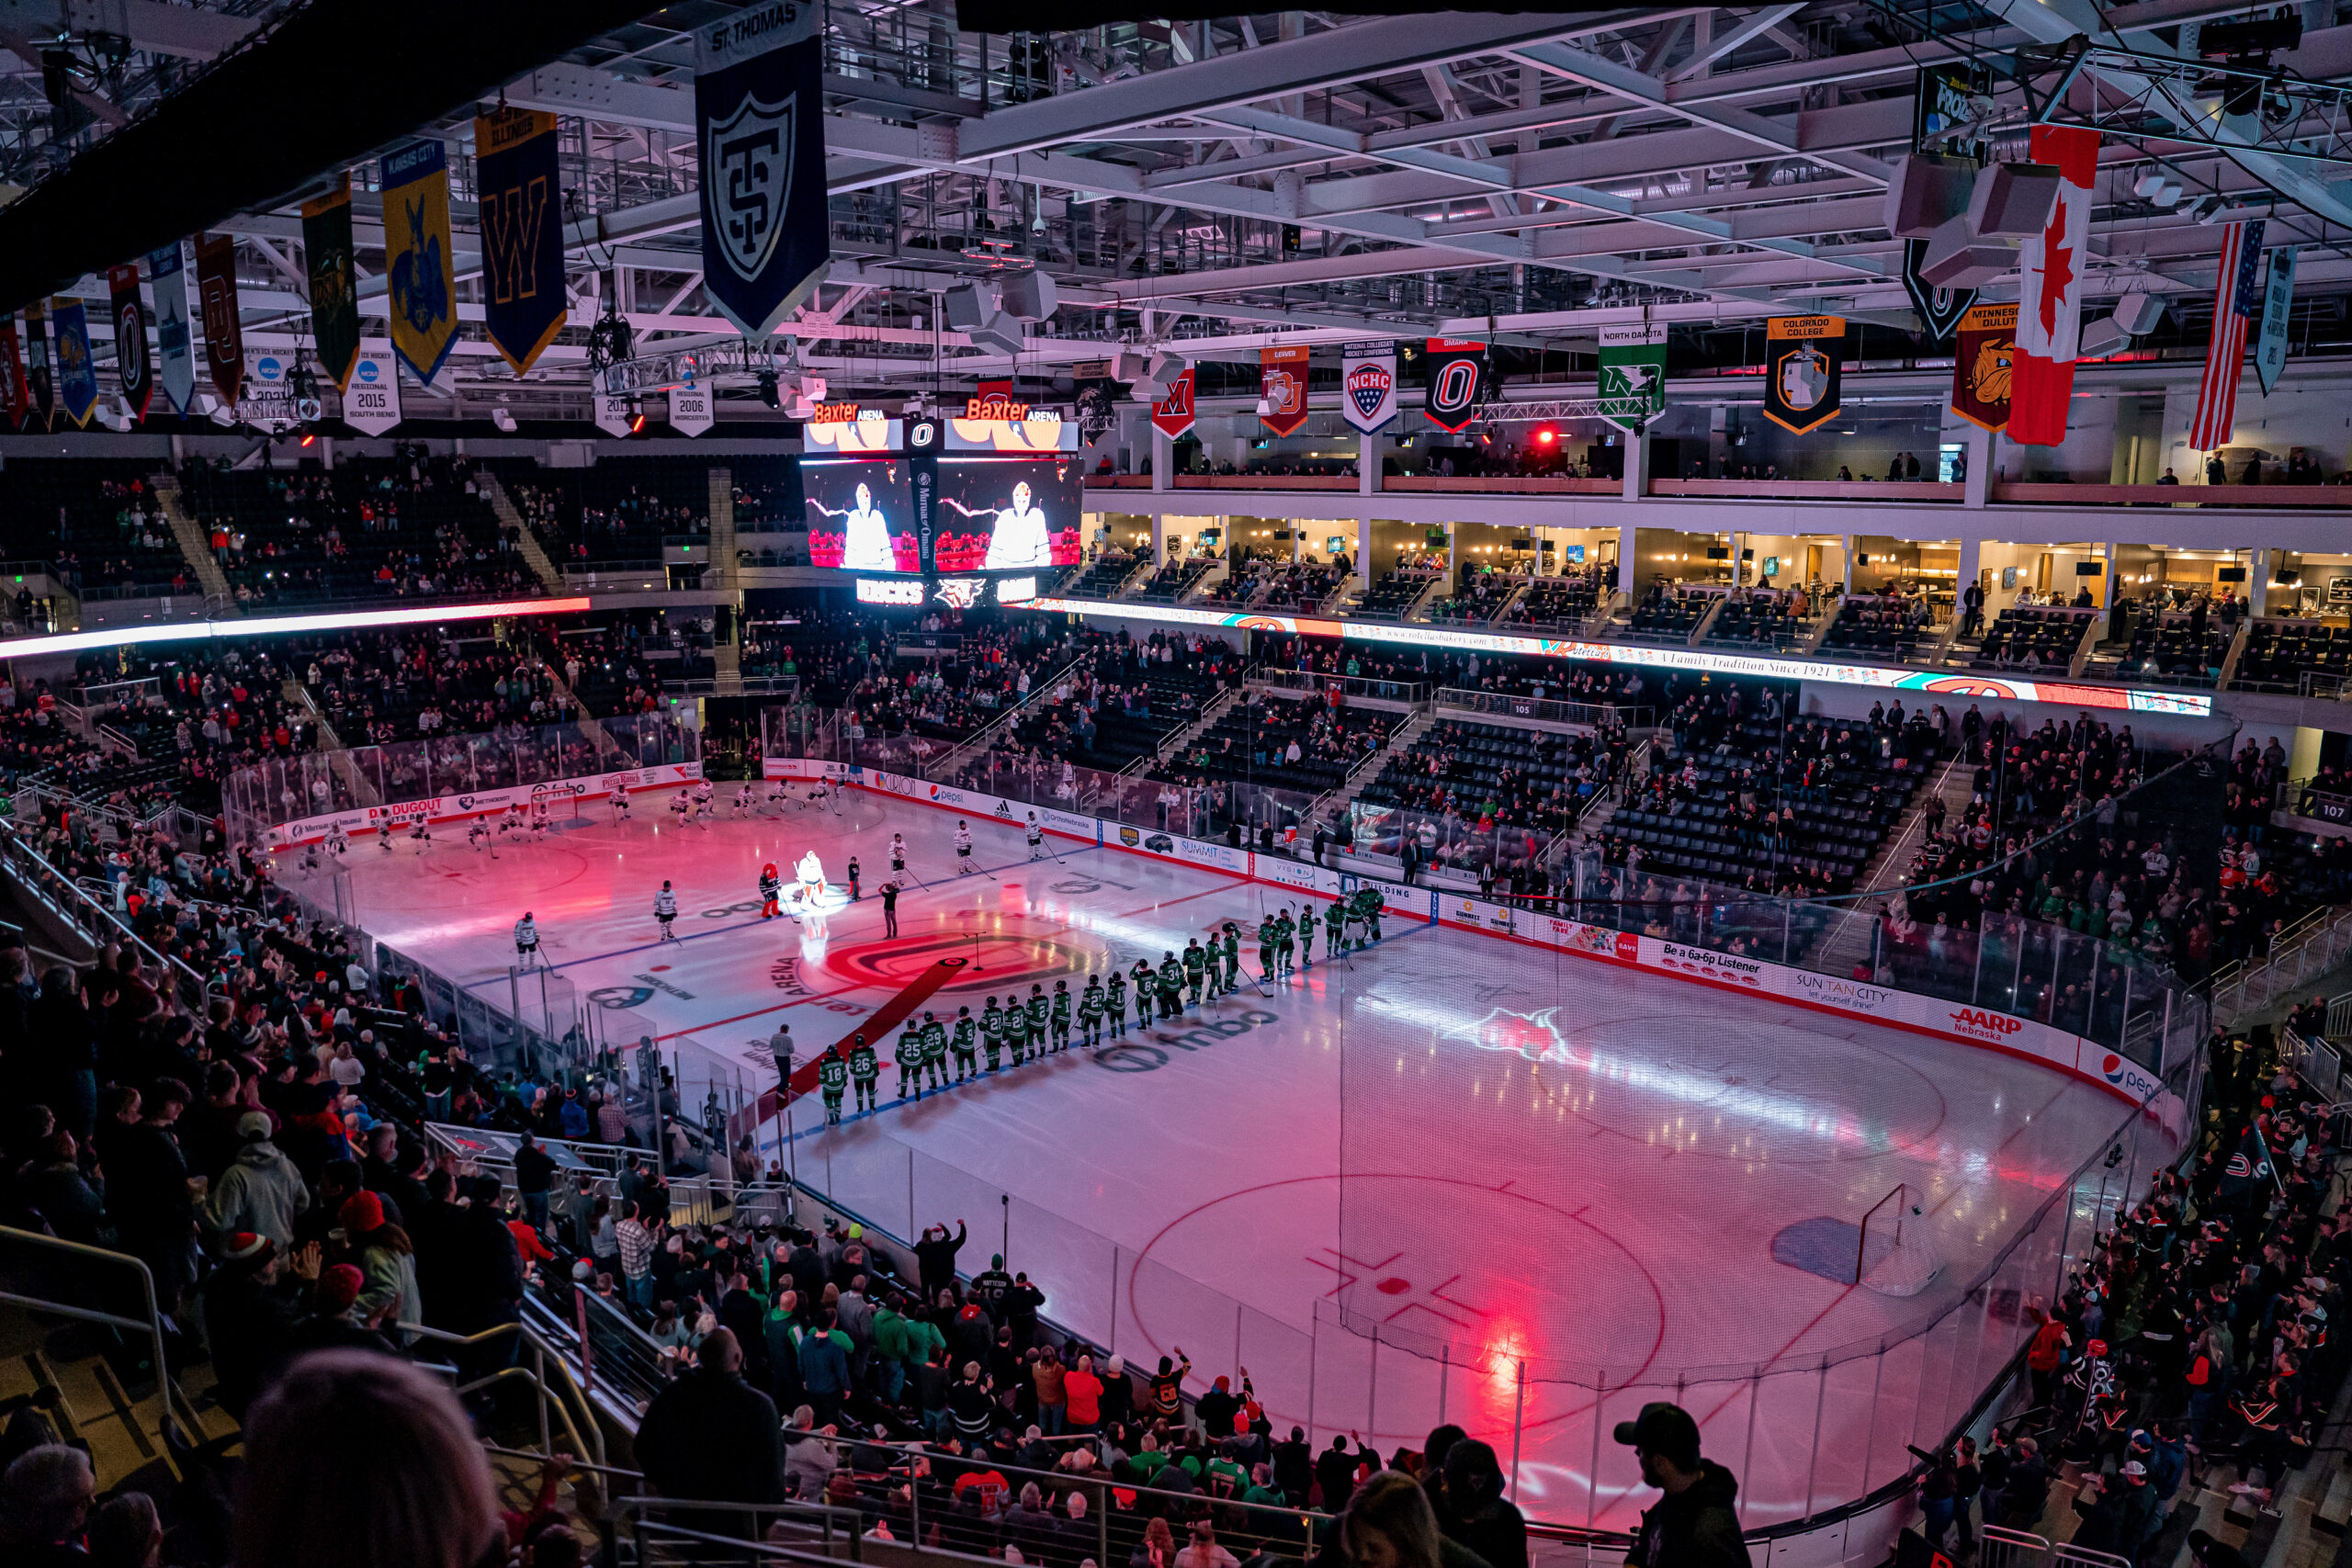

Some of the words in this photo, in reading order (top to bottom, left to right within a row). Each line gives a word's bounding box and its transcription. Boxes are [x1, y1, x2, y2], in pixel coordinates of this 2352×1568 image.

[712, 28, 731, 51] ST.
[734, 2, 797, 40] THOMAS
[492, 116, 535, 147] ILLINOIS
[388, 150, 417, 175] KANSAS
[418, 141, 436, 162] CITY
[481, 175, 548, 305] W
[1782, 318, 1829, 329] COLORADO
[1603, 331, 1631, 341] NORTH
[1631, 329, 1663, 340] DAKOTA
[1787, 327, 1825, 337] COLLEGE
[1344, 342, 1367, 350] NATIONAL
[1367, 340, 1395, 348] COLLEGIATE
[1363, 348, 1394, 356] CONFERENCE
[1274, 349, 1297, 358] DENVER
[1348, 375, 1389, 390] NCHC
[357, 393, 386, 408] 2015
[1157, 378, 1190, 417] M
[680, 400, 704, 412] 2006
[815, 401, 858, 423] Baxter
[857, 410, 885, 422] ARENA
[967, 399, 1029, 422] Baxter
[1027, 411, 1060, 423] ARENA
[924, 638, 936, 647] 102
[1713, 657, 1765, 671] Tradition
[1769, 661, 1799, 675] Since
[1804, 665, 1831, 677] 1921
[1516, 705, 1530, 714] 105
[603, 778, 620, 789] Pizza
[620, 773, 640, 784] Ranch
[475, 795, 511, 805] METHODIST
[941, 789, 964, 803] pepsi
[393, 798, 442, 816] DUGOUT
[2324, 805, 2345, 818] 107
[994, 810, 1013, 820] adidas
[1050, 814, 1090, 829] OrthoNebraska
[1182, 840, 1218, 858] SUMMIT
[1549, 919, 1574, 931] FAMILY
[1618, 942, 1637, 953] SAVE
[1664, 943, 1678, 956] Be
[1679, 949, 1686, 957] a
[1688, 948, 1716, 965] 6a-6p
[1717, 955, 1760, 974] Listener
[771, 956, 816, 996] ARENA
[1168, 969, 1181, 982] 34
[1144, 979, 1151, 992] 8
[1796, 974, 1823, 990] SUN
[1826, 979, 1855, 997] TAN
[1856, 987, 1889, 1003] CITY
[1808, 989, 1819, 998] let
[1820, 992, 1851, 1007] yourself
[1950, 1008, 2022, 1035] AARP
[926, 1032, 942, 1047] 29
[967, 1029, 974, 1042] 9
[1953, 1022, 2002, 1042] Nebraska
[903, 1043, 921, 1058] 25
[854, 1057, 871, 1073] 26
[827, 1067, 842, 1083] 18
